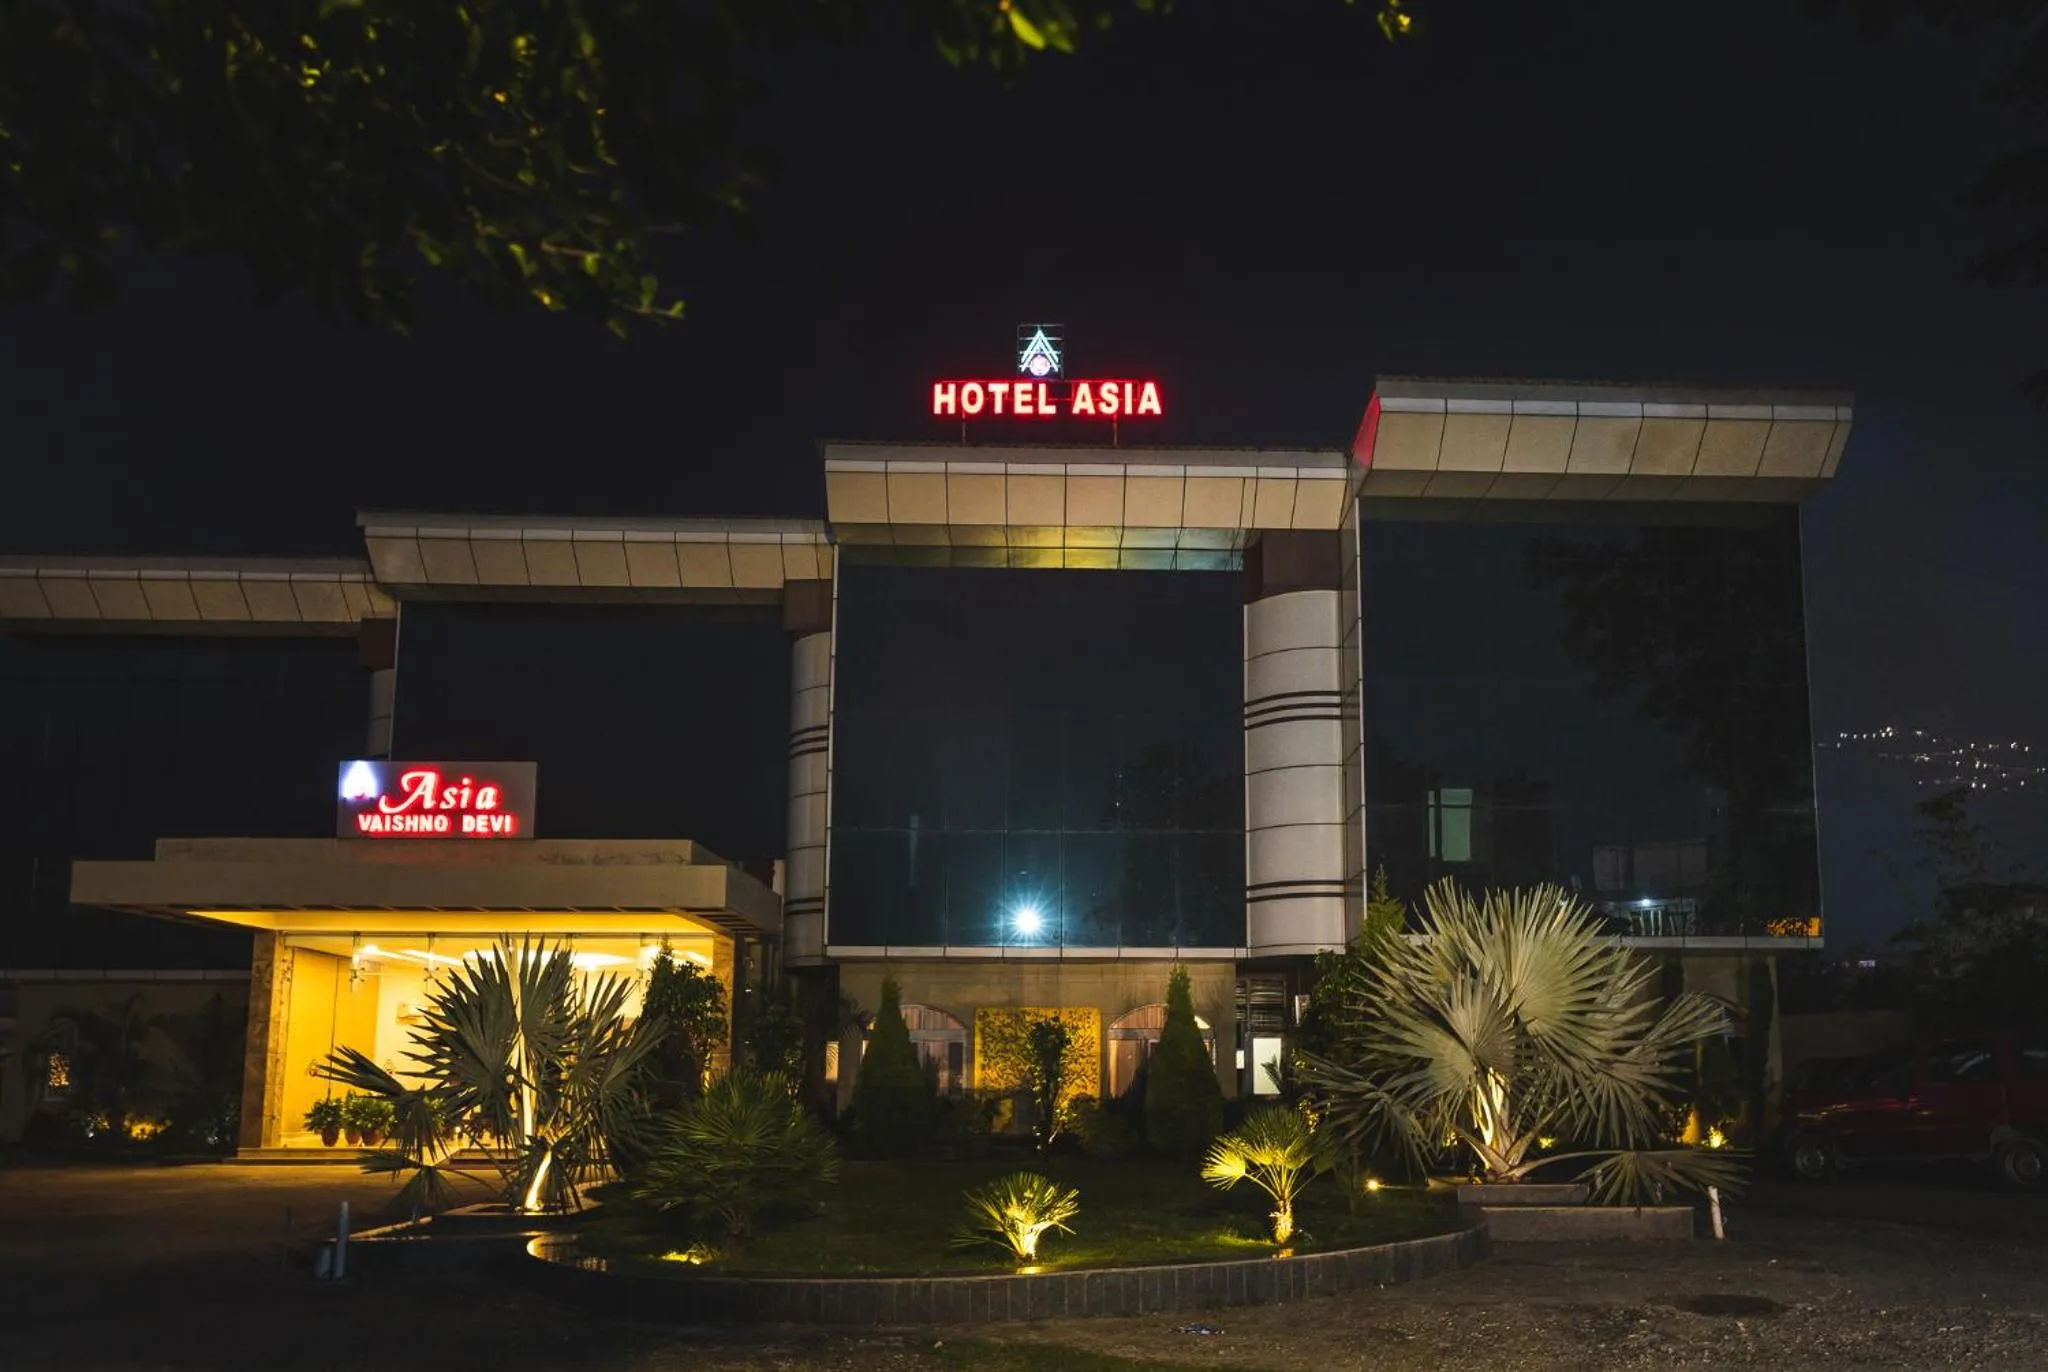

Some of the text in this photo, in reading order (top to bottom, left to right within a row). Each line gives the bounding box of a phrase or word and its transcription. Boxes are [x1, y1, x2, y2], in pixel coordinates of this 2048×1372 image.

[933, 382, 1162, 415] HOTEL ASIA
[378, 771, 498, 814] Asia
[357, 814, 512, 833] VAISHNO DEVI
